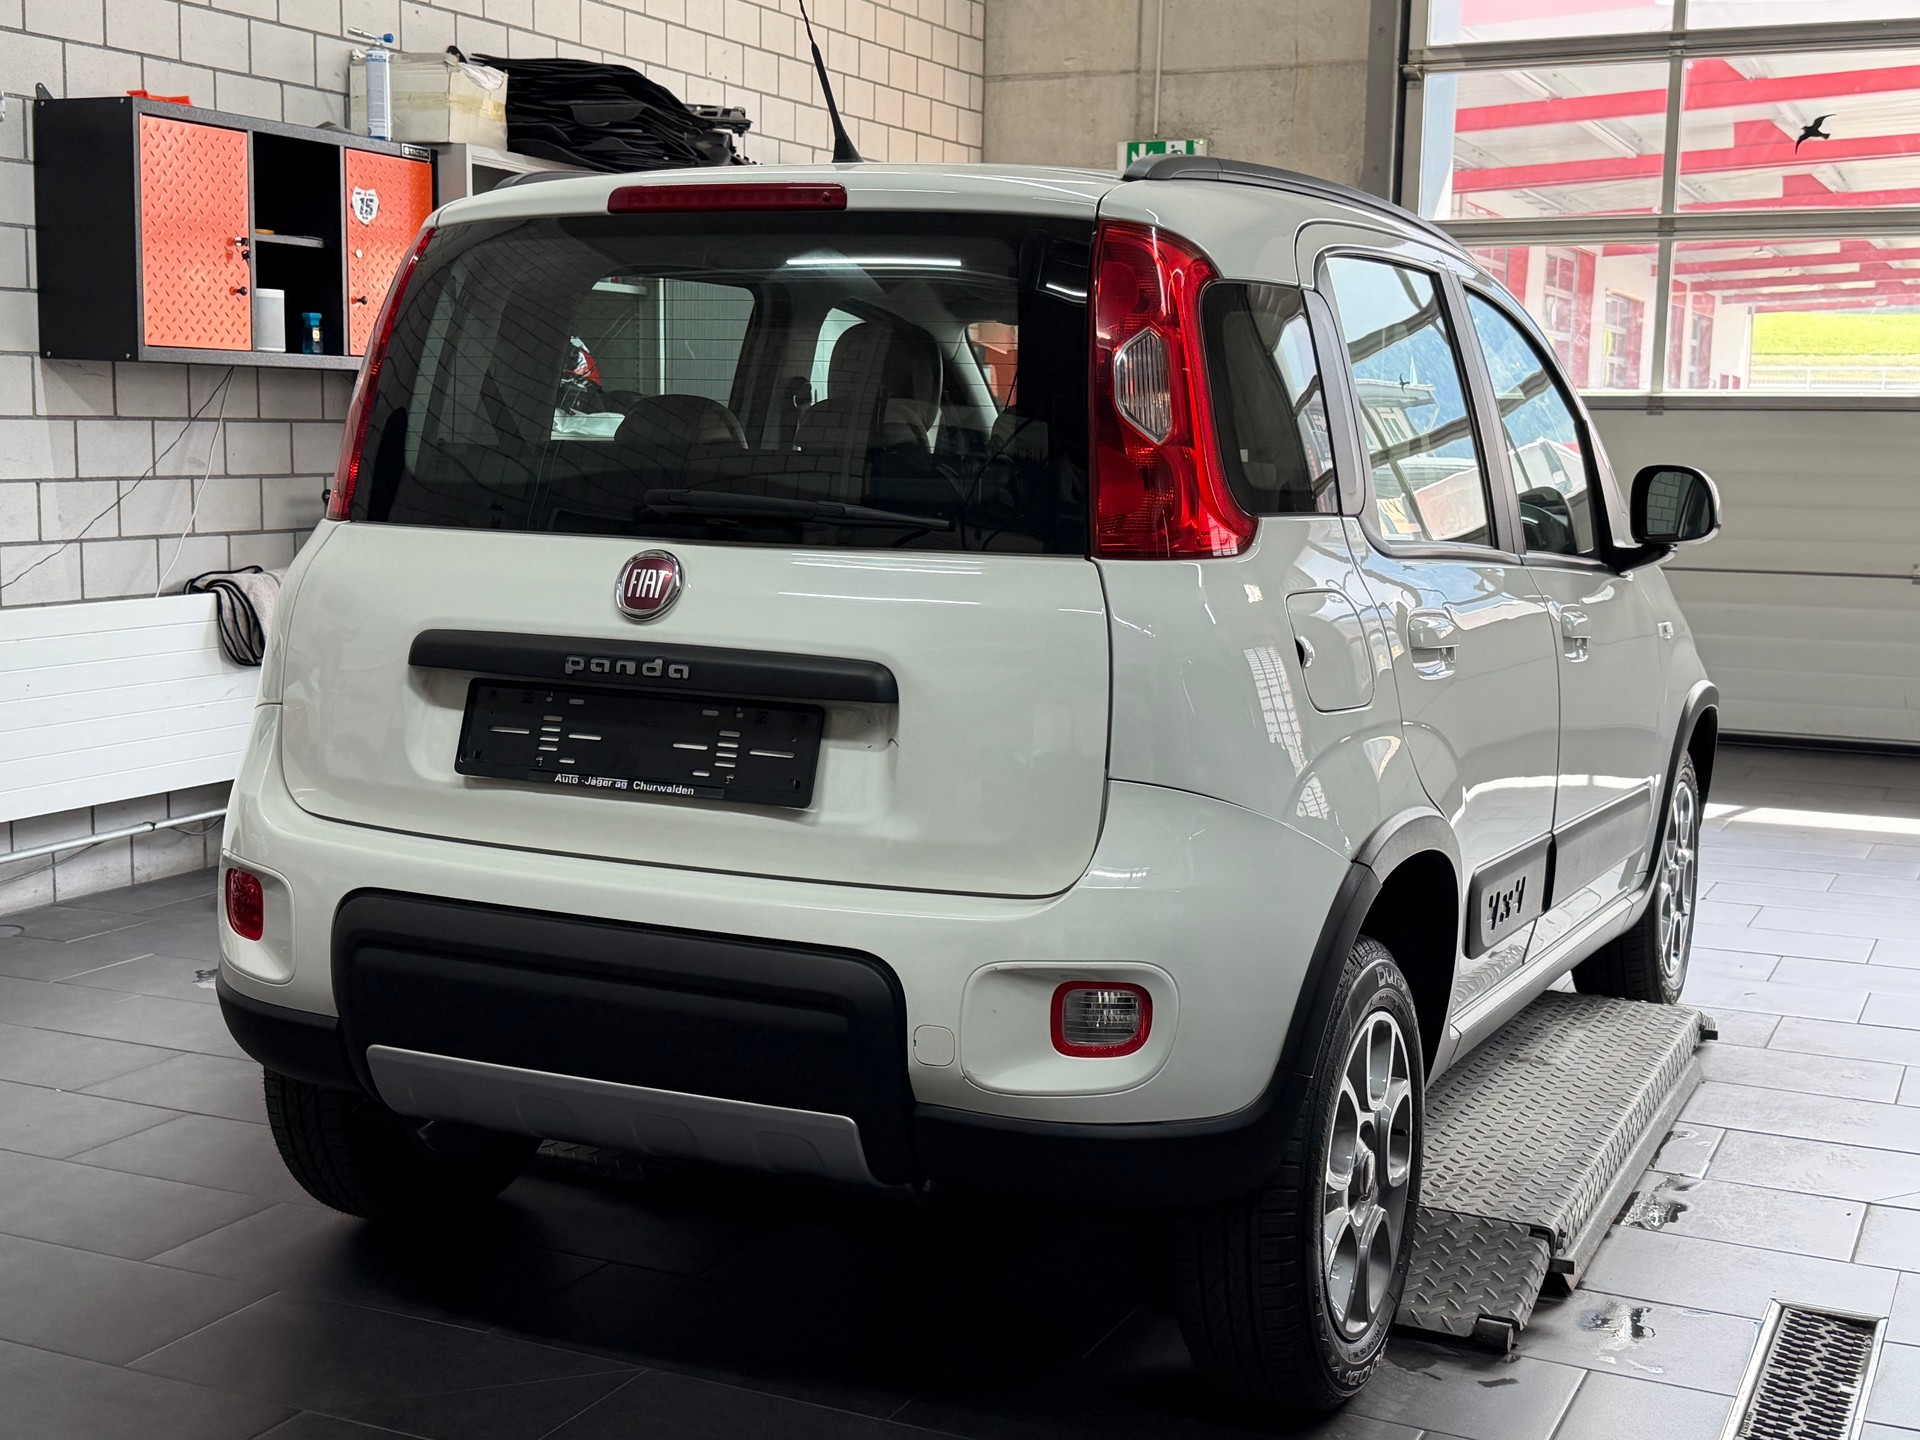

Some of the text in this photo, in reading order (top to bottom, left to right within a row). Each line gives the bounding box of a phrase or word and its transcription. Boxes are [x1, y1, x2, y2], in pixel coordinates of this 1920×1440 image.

[359, 197, 375, 217] 15
[626, 568, 673, 599] FIAT
[564, 655, 690, 679] panda
[554, 773, 579, 785] Auto
[614, 781, 628, 790] ag
[632, 780, 695, 796] Churwalden
